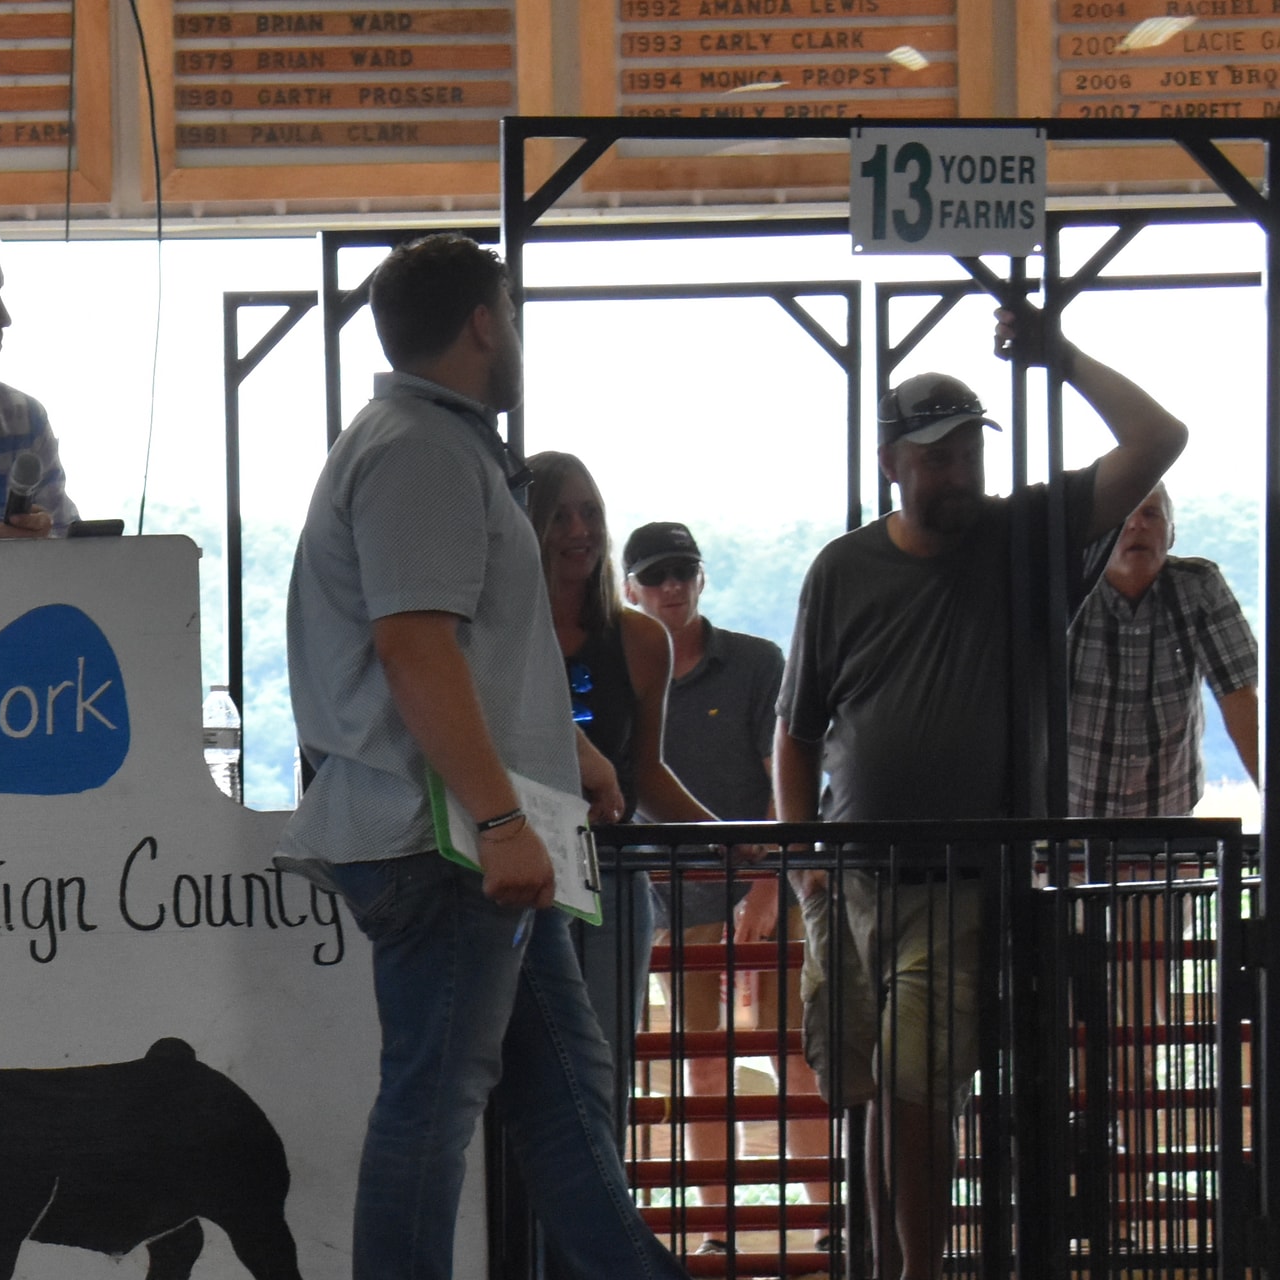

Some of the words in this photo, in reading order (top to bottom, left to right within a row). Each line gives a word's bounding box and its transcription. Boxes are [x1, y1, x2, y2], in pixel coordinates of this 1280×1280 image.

[628, 0, 682, 17] 1992
[699, 0, 792, 15] AMANDA
[812, 0, 879, 13] LEWIS
[1072, 3, 1127, 18] 2004
[1166, 0, 1260, 15] RACHEL
[257, 15, 324, 32] BRIAN
[350, 14, 413, 31] WARD
[627, 36, 683, 53] 1993
[700, 33, 774, 51] CARLY
[792, 31, 864, 49] CLARK
[1183, 31, 1245, 52] LACIE
[180, 52, 233, 70] 1979
[258, 51, 325, 69] BRIAN
[352, 49, 414, 66] WARD
[628, 73, 683, 89] 1994
[701, 70, 783, 88] MONICA
[803, 67, 892, 85] PROPST
[1075, 75, 1132, 90] 2006
[1160, 71, 1219, 88] JOEY
[180, 89, 233, 106] 1980
[258, 88, 332, 105] GARTH
[359, 87, 464, 104] PROSSER
[1161, 102, 1242, 118] GARRETT
[251, 126, 323, 143] PAULA
[348, 125, 419, 142] CLARK
[939, 155, 1036, 185] YODER
[860, 141, 933, 243] 13
[939, 201, 1036, 230] FARMS
[120, 836, 345, 966] County
